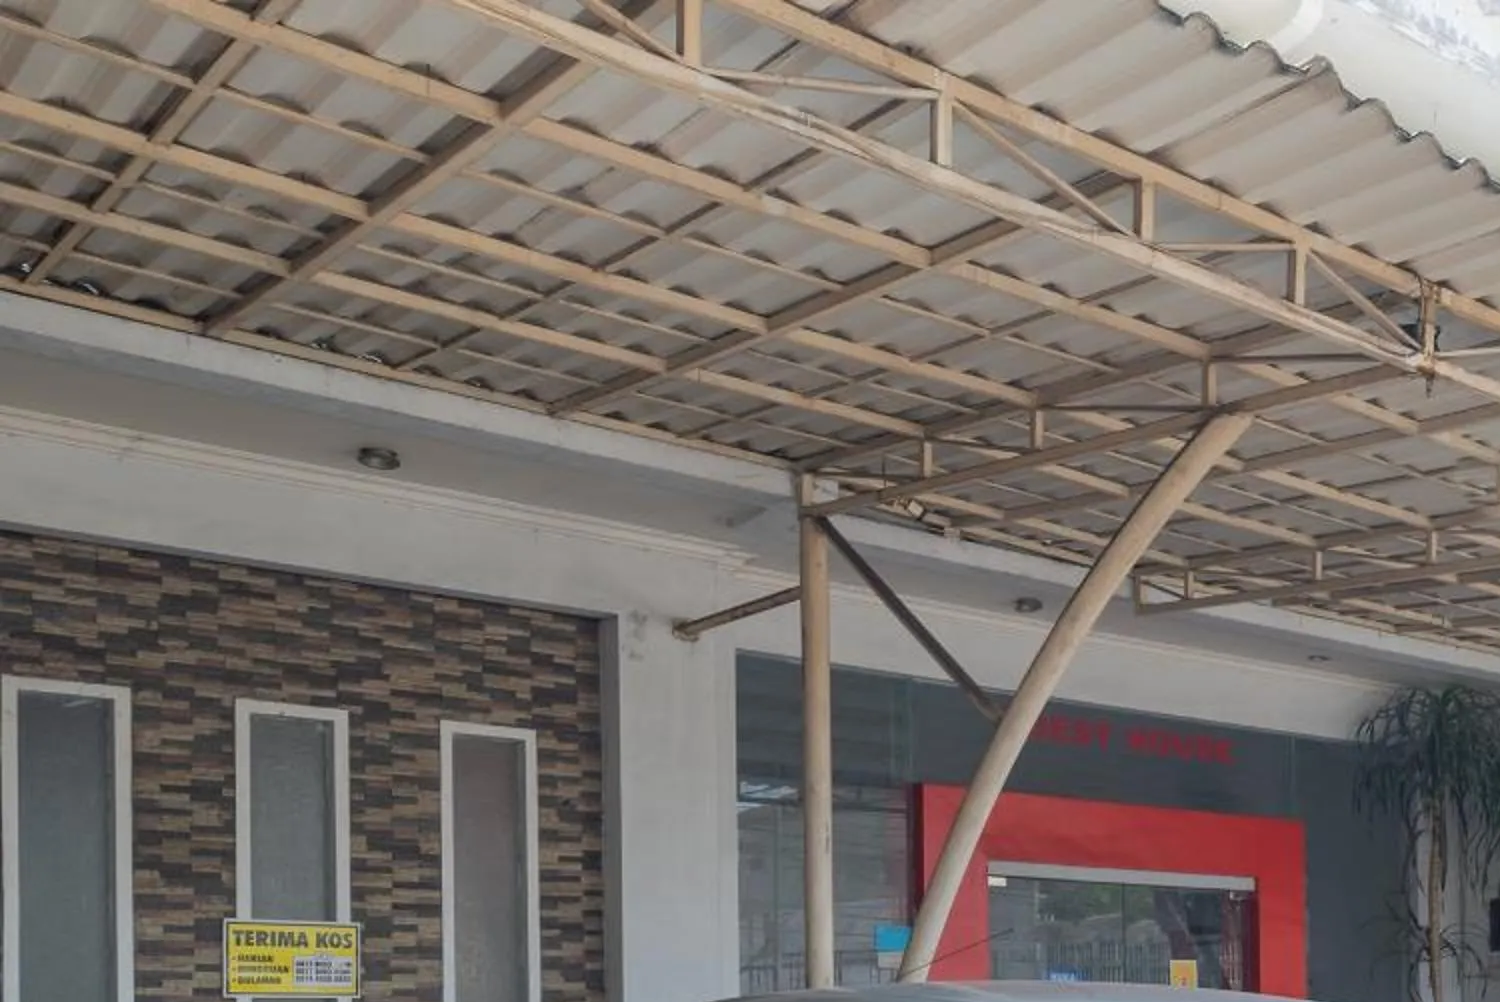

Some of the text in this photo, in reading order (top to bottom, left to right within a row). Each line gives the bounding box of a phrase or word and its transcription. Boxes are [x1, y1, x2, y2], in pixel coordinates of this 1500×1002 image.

[1029, 714, 1112, 751] UEST
[231, 929, 354, 949] TERIMA KOS
